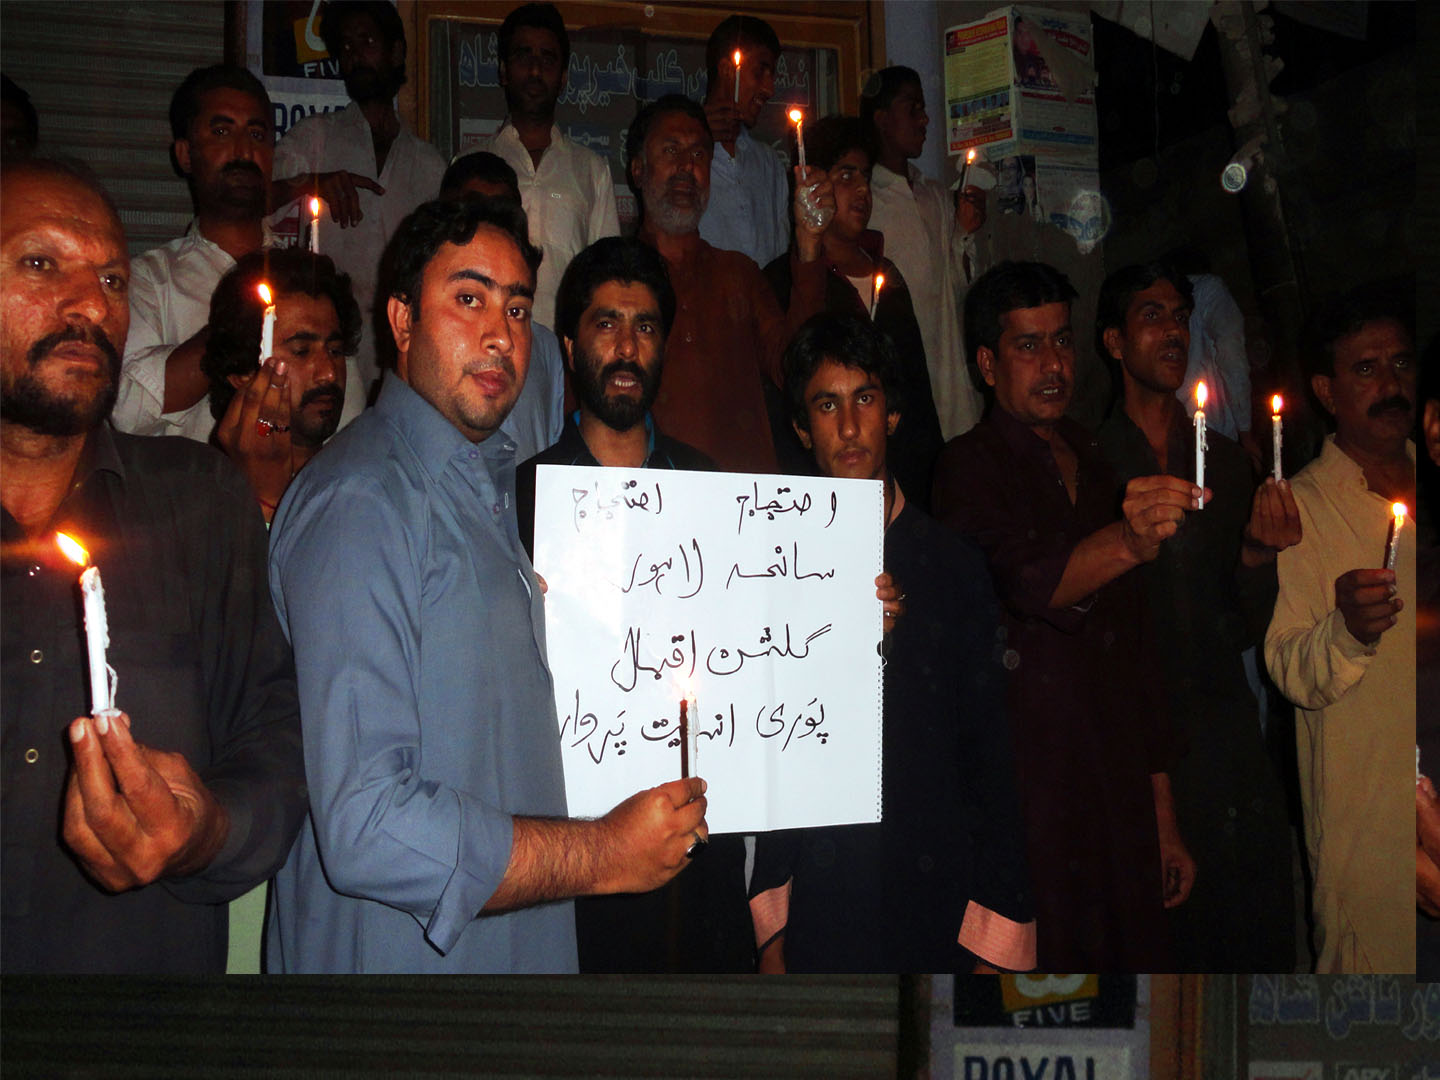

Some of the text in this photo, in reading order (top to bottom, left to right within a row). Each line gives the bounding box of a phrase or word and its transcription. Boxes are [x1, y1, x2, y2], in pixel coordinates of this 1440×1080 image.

[303, 60, 341, 78] FIV
[618, 538, 703, 599] لاہور
[610, 623, 832, 692] گلشن اقبال
[1013, 1002, 1092, 1027] FIVE
